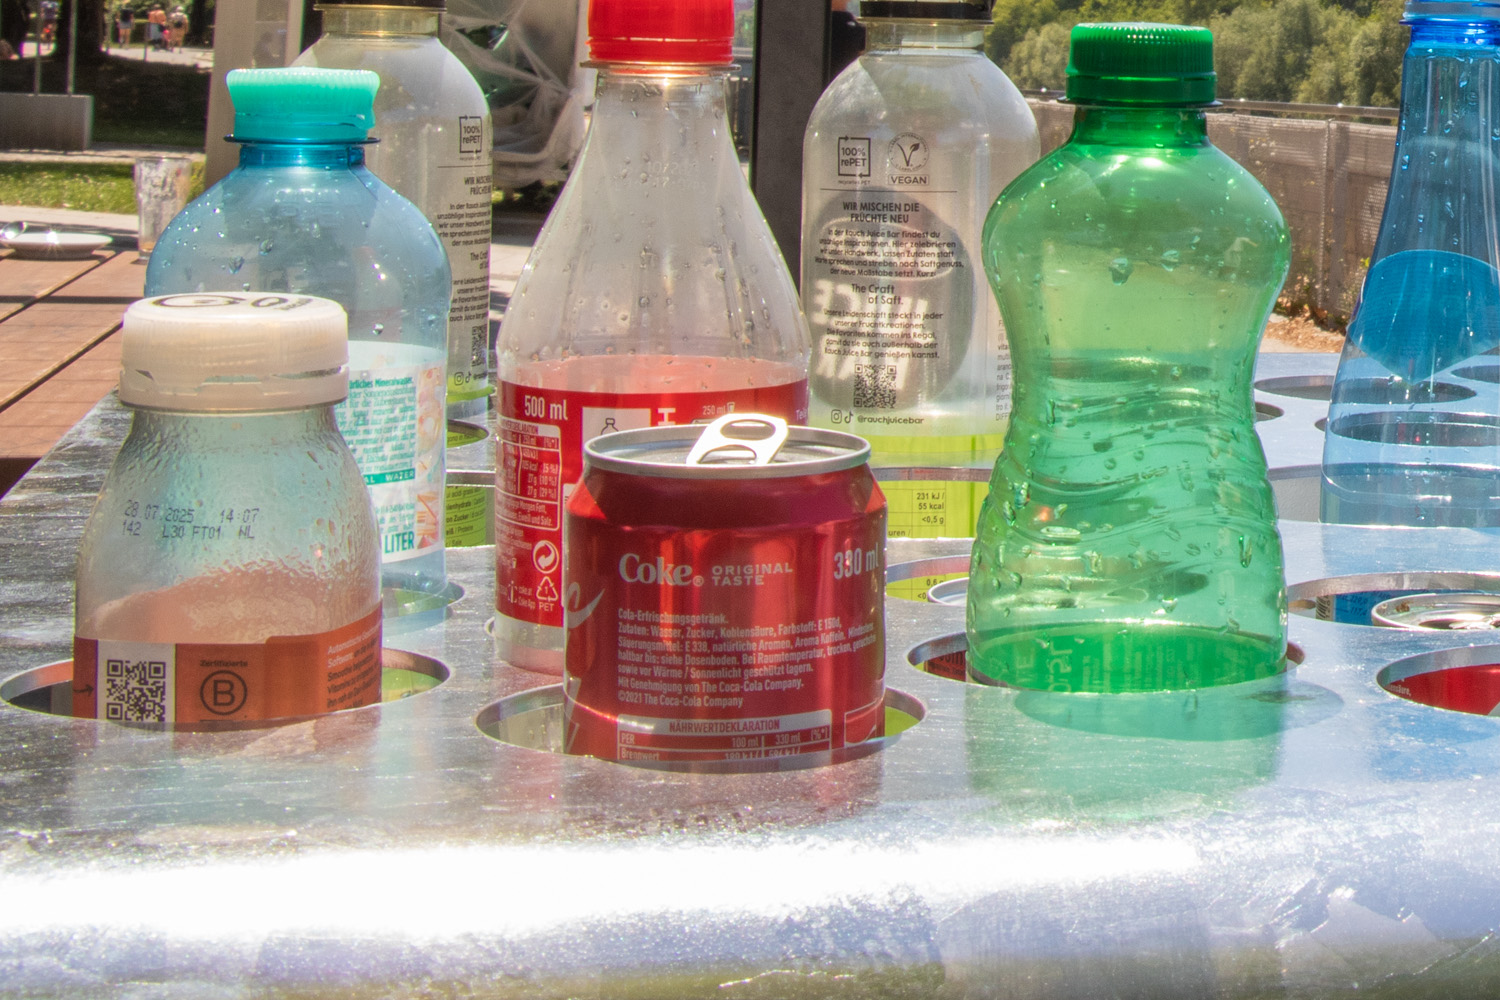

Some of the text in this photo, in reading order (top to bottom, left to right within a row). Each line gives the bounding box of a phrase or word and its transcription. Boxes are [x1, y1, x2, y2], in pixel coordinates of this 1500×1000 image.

[841, 147, 866, 157] 100%
[841, 158, 867, 167] rePET
[891, 175, 927, 185] VEGAN
[843, 201, 920, 212] WIR MISCHEN DIE
[850, 212, 909, 223] FRÜCHTE NEU
[867, 230, 885, 238] Juice
[886, 230, 900, 238] Bar
[901, 230, 928, 238] findest
[910, 240, 956, 248] zelebrieren
[906, 250, 936, 258] Zutaten
[937, 250, 955, 258] statt
[899, 260, 918, 268] nach
[920, 260, 964, 270] Saftgenuss,
[894, 270, 916, 278] setzt.
[851, 283, 895, 294] The Craft
[868, 295, 904, 305] of Saft.
[888, 311, 913, 319] steckt
[922, 312, 944, 320] jeder
[923, 341, 938, 349] der
[874, 350, 910, 360] genießen
[912, 351, 940, 359] kannst.
[524, 394, 568, 420] 500 ml
[703, 405, 726, 416] 250 ml
[857, 415, 925, 425] @rauchjuicebar
[385, 470, 415, 482] WATER
[916, 492, 940, 500] 231 kJ
[918, 502, 945, 510] 55 kcal
[124, 500, 260, 524] 28.07.2025 14:07
[921, 515, 944, 525] <0,5 g
[122, 520, 142, 536] 142
[238, 525, 255, 539] NL
[384, 531, 415, 554] LITER
[833, 542, 879, 580] 330 ml
[618, 552, 693, 587] Coke
[712, 562, 794, 576] ORIGINAL
[712, 575, 765, 587] TASTE
[538, 602, 554, 612] PET
[618, 608, 729, 626] Cola-Erfrischungsgetränk.
[618, 622, 649, 636] Zutaten:
[650, 625, 684, 639] Wasser,
[686, 626, 718, 640] Zucker,
[720, 625, 777, 639] Kohlensäure,
[778, 620, 817, 636] Farbstoff:
[618, 636, 683, 653] Säuerungsmittel:
[692, 641, 711, 654] 338,
[712, 640, 757, 652] natürliche
[758, 639, 793, 651] Aromen,
[795, 635, 819, 648] Aroma
[618, 642, 852, 666] haltbar bis: siehe Dosenboden. Bei Raumtemperatur, trocken,
[200, 659, 249, 668] Zertifizierte
[618, 663, 638, 674] sowie
[640, 666, 652, 676] vor
[653, 665, 682, 678] Wärme
[690, 667, 741, 679] Sonnenlicht
[743, 664, 785, 680] geschützt
[786, 662, 813, 676] lagern.
[618, 676, 804, 694] Mit Genehmigung von The Coca-Cola Company.
[644, 692, 658, 705] The
[659, 694, 702, 708] Coca-Cola
[703, 695, 744, 709] Company
[668, 718, 780, 734] NÄHRWERTDEKLARATION
[621, 732, 635, 745] PER
[732, 737, 746, 748] 100
[747, 736, 759, 748] ml
[775, 733, 790, 745] 330
[791, 732, 800, 744] ml
[621, 750, 660, 761] Brennwert
